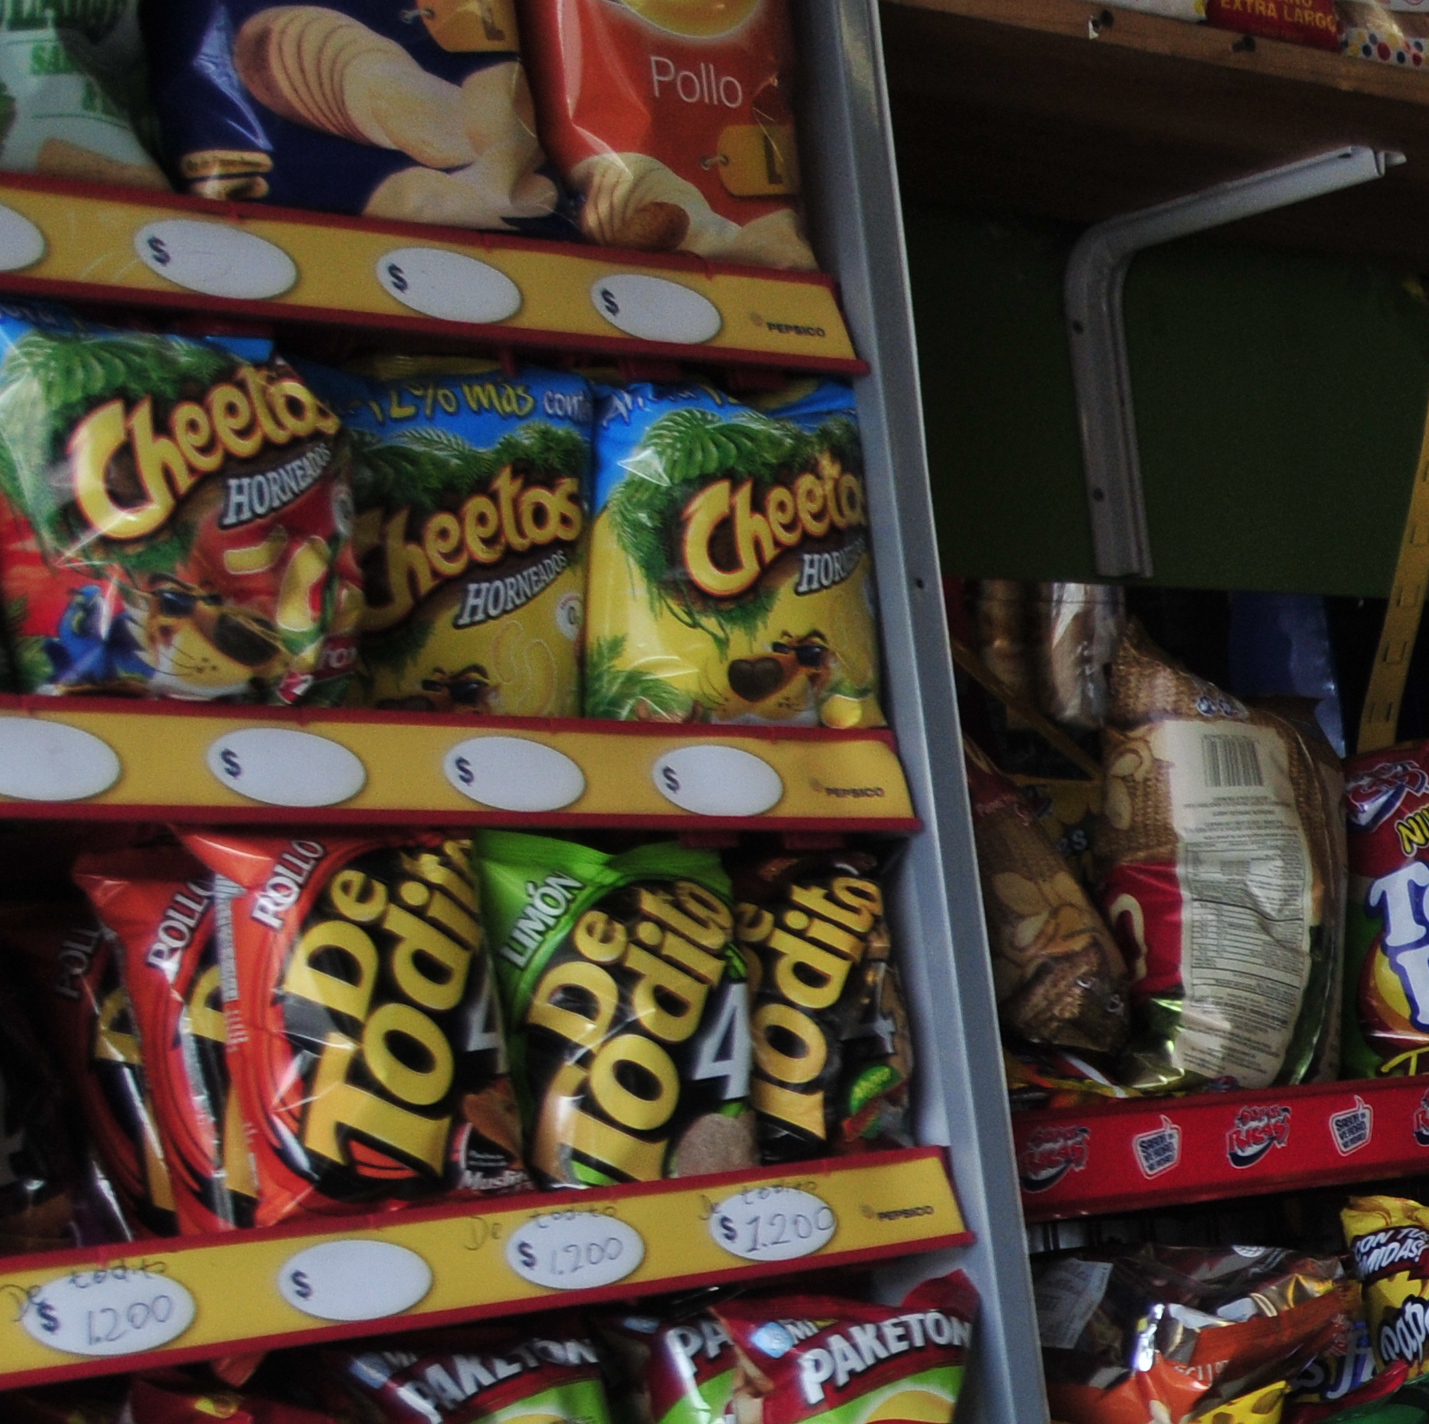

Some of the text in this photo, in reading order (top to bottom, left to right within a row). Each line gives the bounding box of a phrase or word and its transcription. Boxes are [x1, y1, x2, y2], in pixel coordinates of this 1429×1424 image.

[649, 54, 744, 110] Pollo
[453, 549, 568, 629] HORNEADOS
[250, 837, 326, 930] POLLO
[500, 870, 585, 969] LIMÓN
[282, 867, 390, 1037] De
[524, 909, 629, 1062] De
[531, 879, 735, 1183] Todito
[800, 1305, 972, 1406] PAKETÓN
